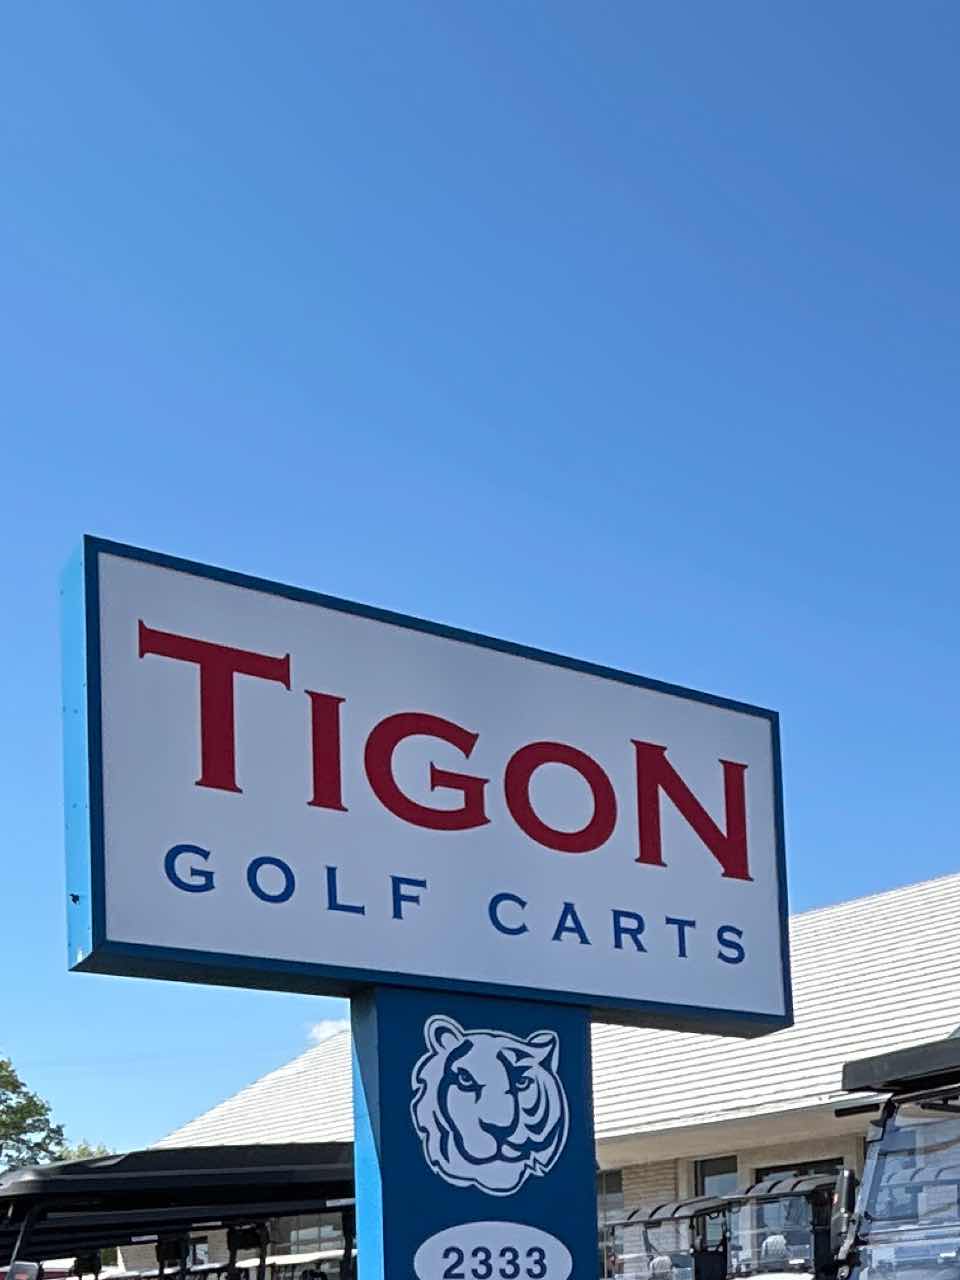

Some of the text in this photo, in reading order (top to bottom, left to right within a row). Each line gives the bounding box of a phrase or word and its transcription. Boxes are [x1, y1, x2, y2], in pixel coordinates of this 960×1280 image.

[138, 619, 754, 882] TIGON
[163, 843, 747, 965] GOLF CARTS
[442, 1245, 548, 1280] 2333
